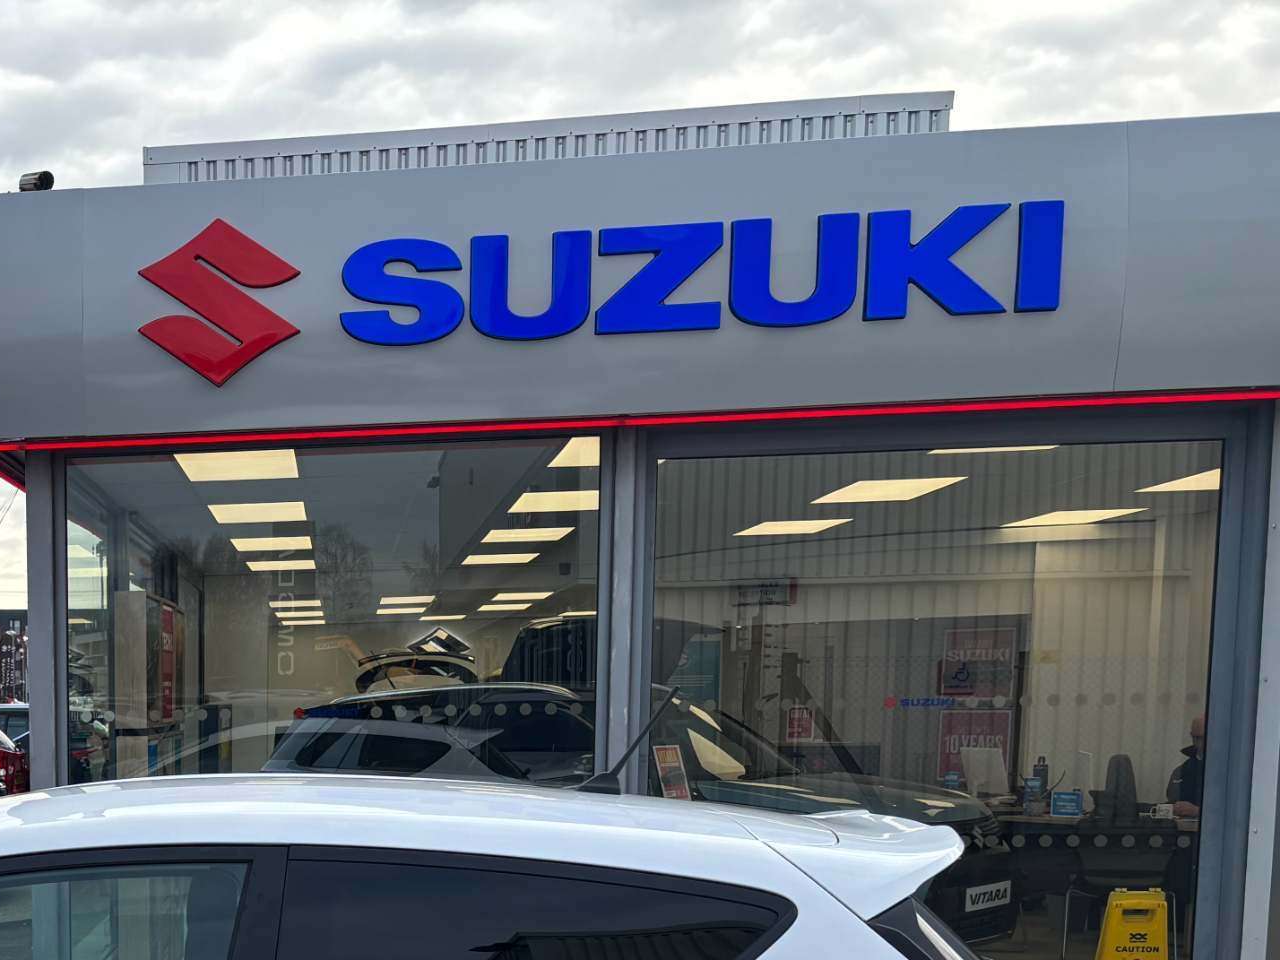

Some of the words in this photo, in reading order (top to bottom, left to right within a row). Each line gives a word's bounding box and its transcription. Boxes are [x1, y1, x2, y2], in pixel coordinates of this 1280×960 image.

[339, 200, 1065, 347] SUZUKI
[900, 697, 956, 707] SUZUKI
[945, 735, 959, 754] 10
[961, 735, 1004, 749] YEARS
[969, 887, 1008, 906] VITARA
[1115, 945, 1160, 953] CAUTION
